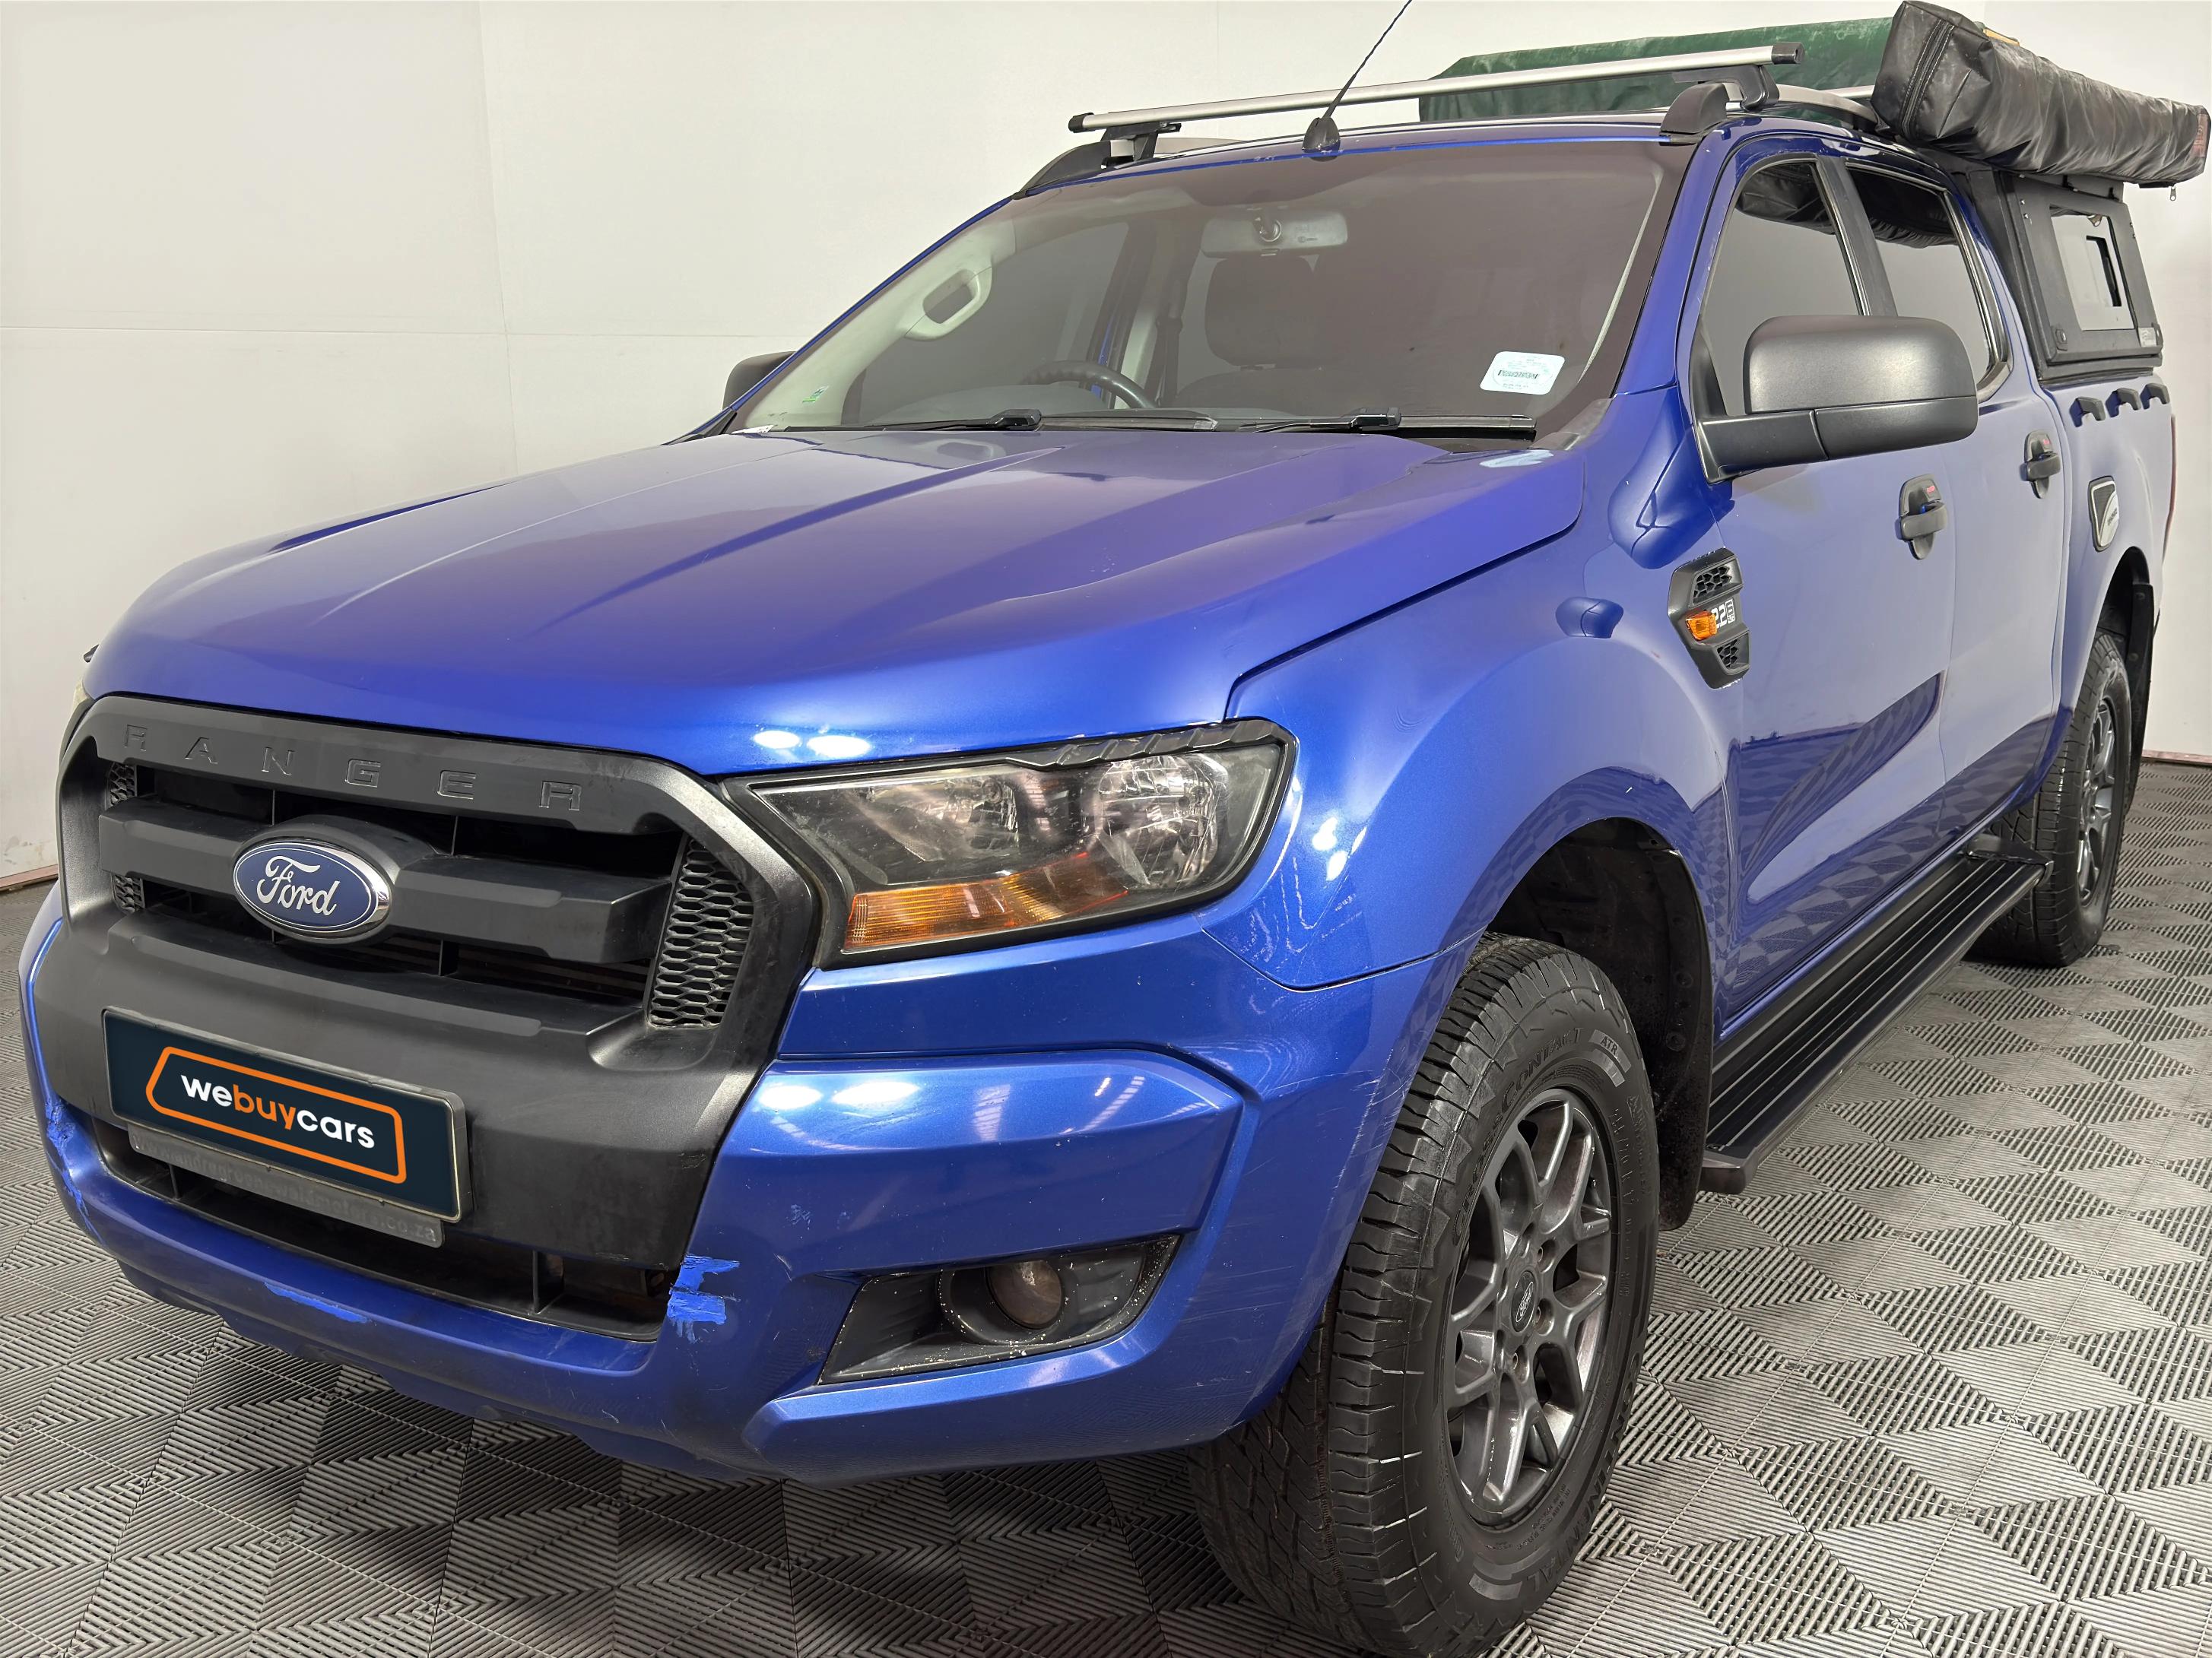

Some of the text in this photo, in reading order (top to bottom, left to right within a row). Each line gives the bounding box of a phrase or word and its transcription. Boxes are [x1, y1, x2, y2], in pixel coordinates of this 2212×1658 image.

[122, 724, 582, 811] RANGER
[256, 855, 339, 917] Ford
[1599, 1035, 1619, 1055] ATR
[180, 1073, 376, 1149] webuycars
